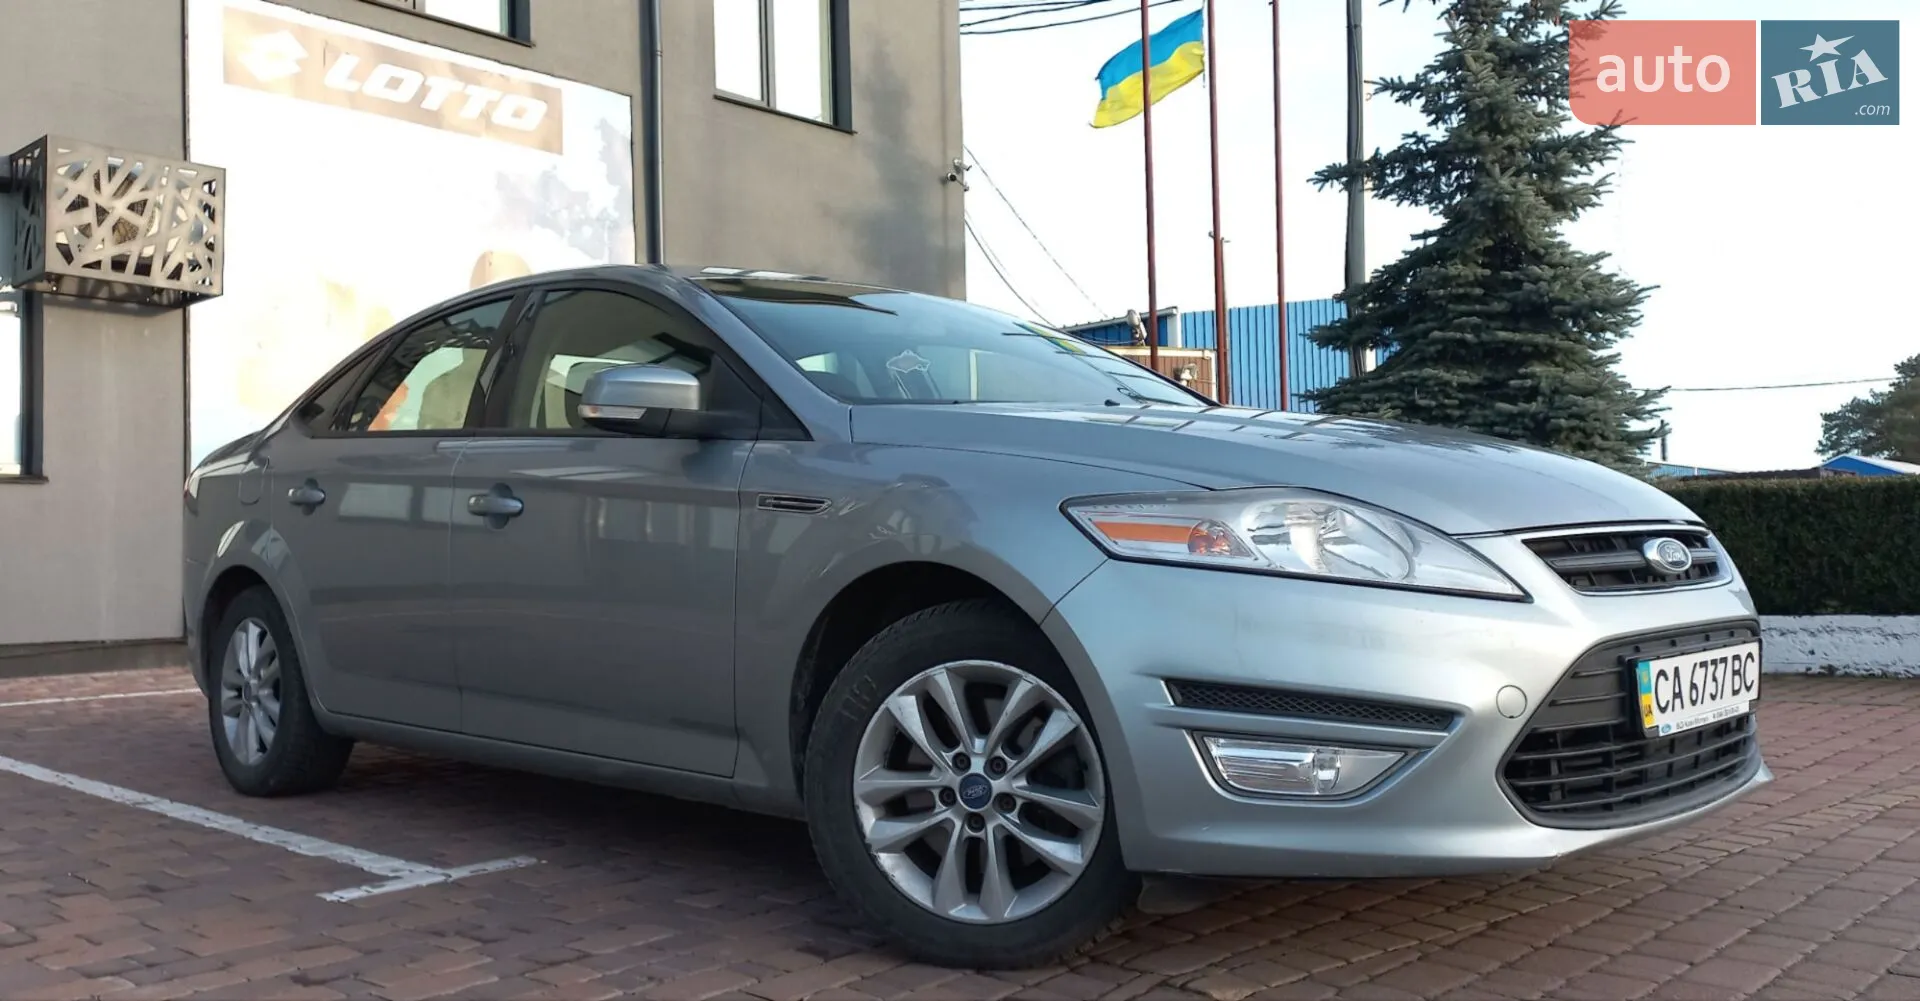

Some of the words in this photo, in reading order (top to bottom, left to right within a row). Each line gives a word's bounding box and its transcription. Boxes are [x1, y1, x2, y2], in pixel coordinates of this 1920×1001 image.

[323, 53, 549, 131] LOTTO
[1643, 703, 1653, 717] UA
[1654, 665, 1684, 714] CA
[1689, 656, 1728, 707] 6737
[1731, 651, 1755, 697] BC
